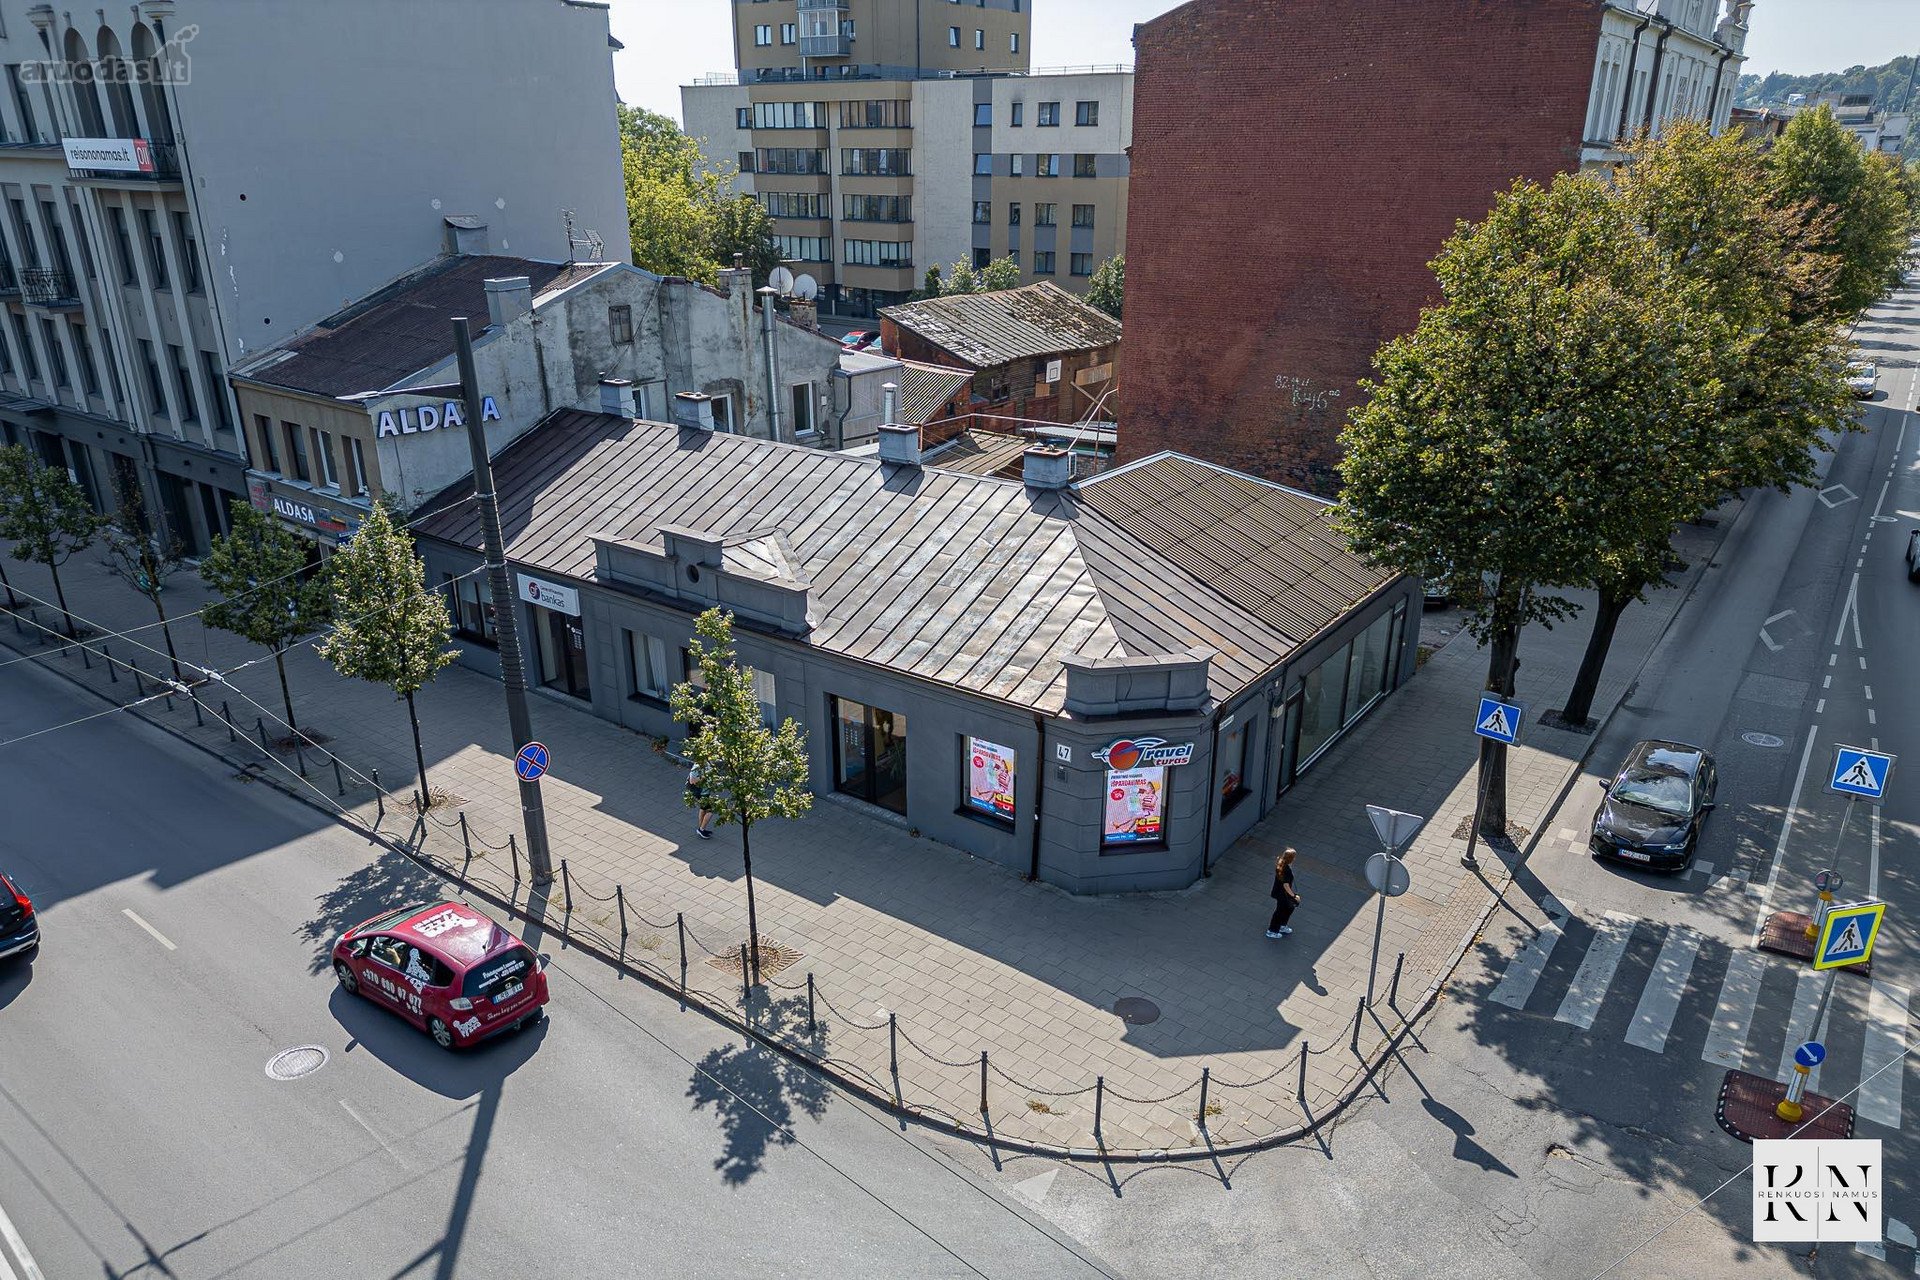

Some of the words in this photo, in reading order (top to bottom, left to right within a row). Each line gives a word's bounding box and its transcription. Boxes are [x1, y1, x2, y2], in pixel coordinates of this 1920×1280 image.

[378, 396, 501, 438] ALDAA
[273, 498, 316, 524] ALDASA
[1058, 743, 1070, 760] 47
[1155, 757, 1189, 767] turas
